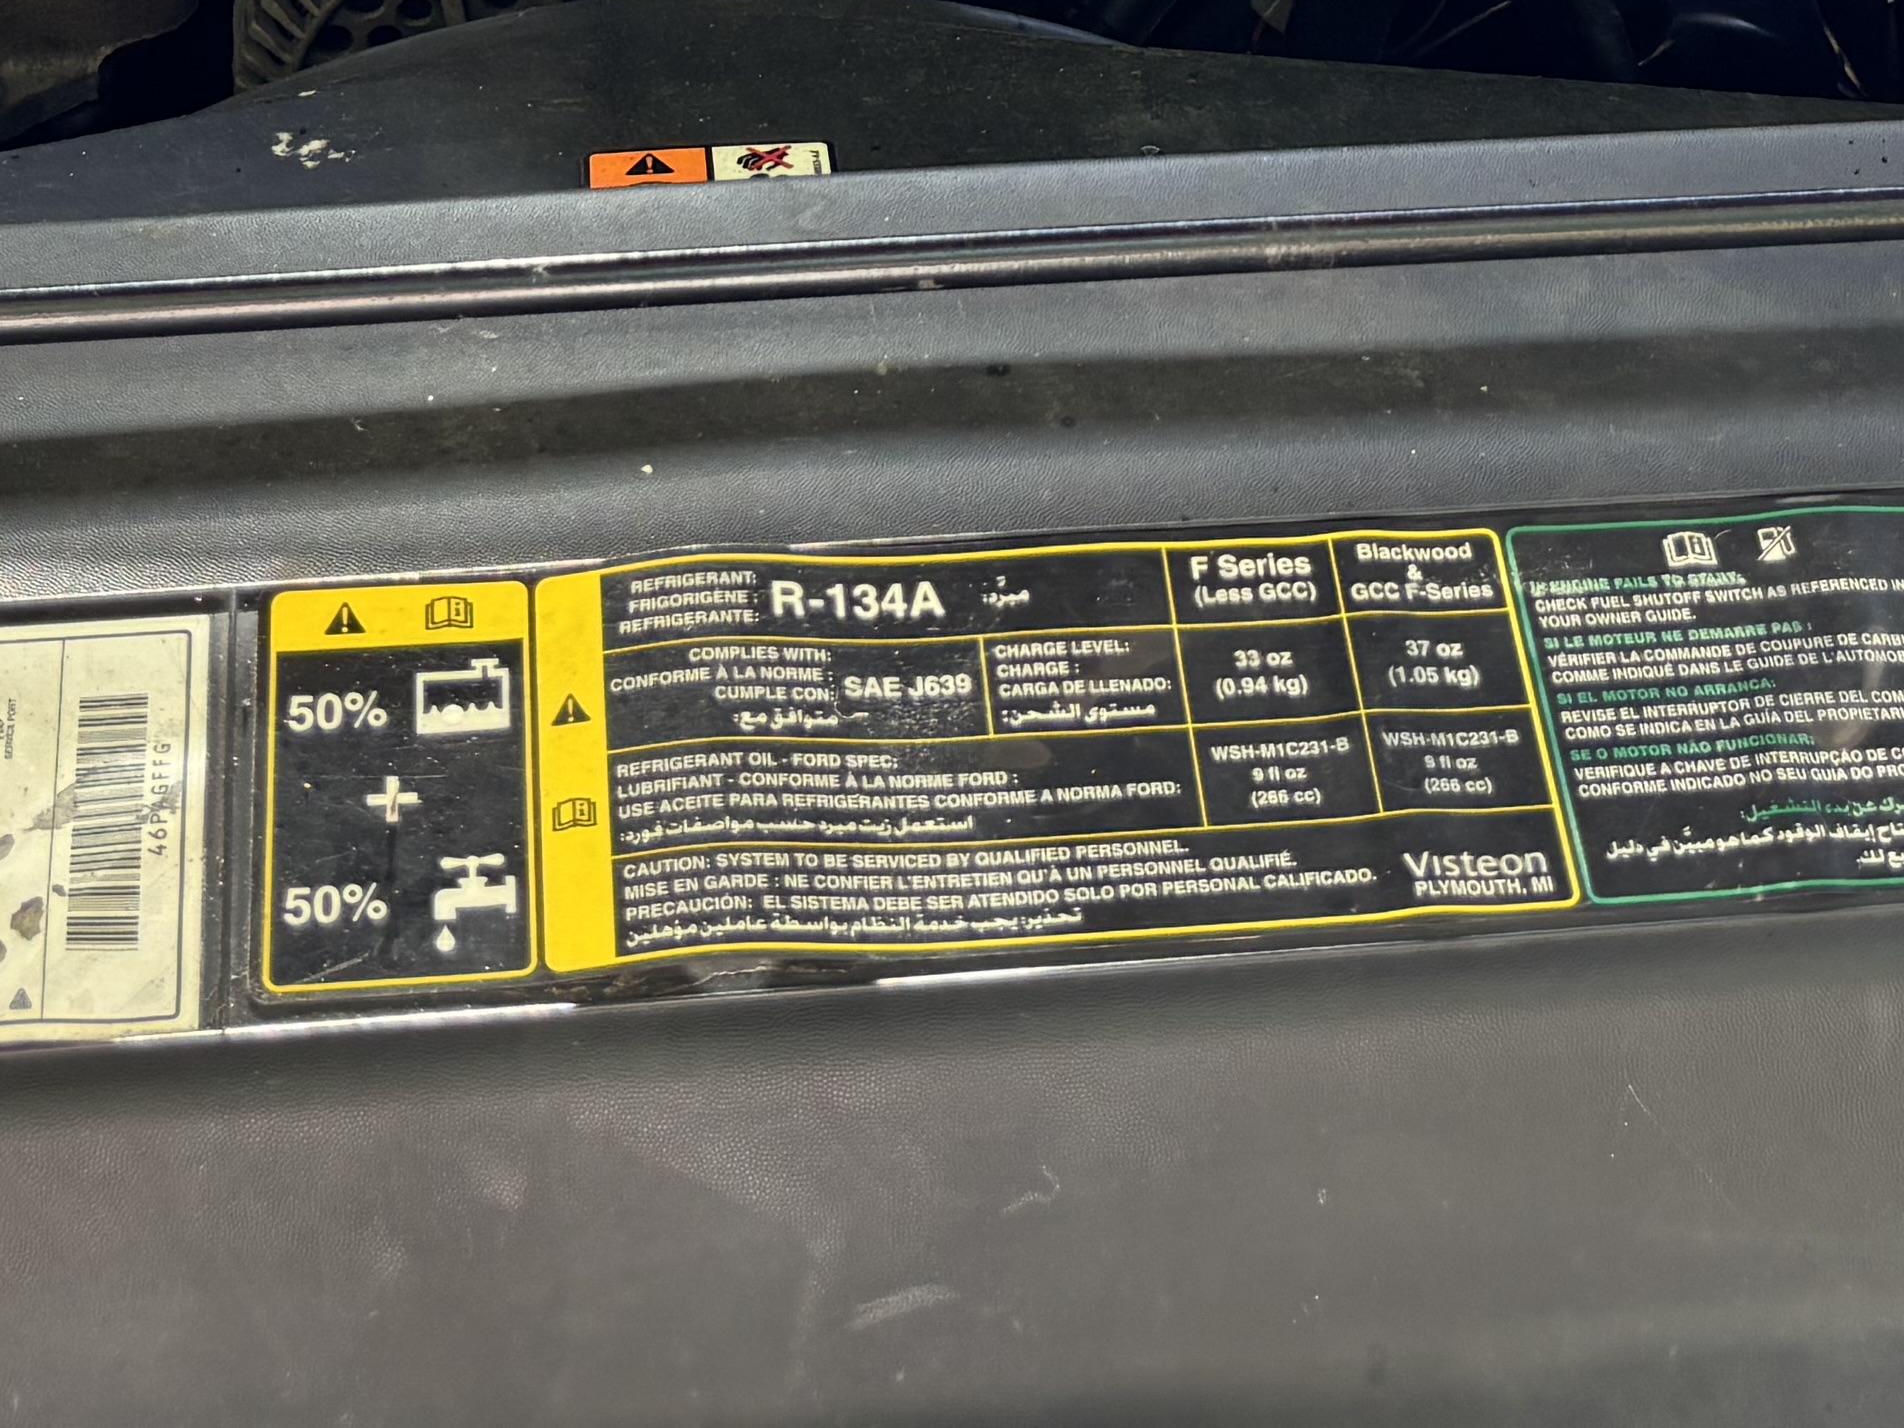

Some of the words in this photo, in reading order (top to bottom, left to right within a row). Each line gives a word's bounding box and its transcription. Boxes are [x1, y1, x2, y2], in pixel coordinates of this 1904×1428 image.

[1356, 541, 1472, 561] Blackwood
[1190, 555, 1208, 580] F
[1216, 552, 1312, 579] Series
[1404, 563, 1425, 582] &
[770, 579, 946, 620] R-134A
[1194, 585, 1254, 608] (Less
[1258, 580, 1317, 601] GCC)
[1350, 581, 1400, 601] GCC
[1404, 581, 1494, 601] F-Series
[1534, 597, 1588, 613] CHECK
[1590, 595, 1631, 610] FUEL
[1632, 590, 1701, 607] SHUTOFF
[1704, 586, 1764, 603] SWITCH
[1767, 584, 1787, 599] AS
[1790, 577, 1888, 595] REFERENCED
[1538, 613, 1582, 628] YOUR
[1584, 610, 1642, 626] OWNER
[1645, 607, 1696, 622] GUIDE.
[992, 641, 1068, 659] CHARGE
[1070, 639, 1130, 655] LEVEL:
[1233, 649, 1261, 668] 33
[1265, 651, 1293, 667] oz
[1405, 639, 1430, 656] 37
[1435, 642, 1464, 658] oz
[843, 675, 903, 699] SAE
[907, 672, 972, 699] J639
[1388, 665, 1439, 687] (1.05
[1443, 664, 1480, 687] kg)
[1215, 675, 1268, 700] (0.94
[1272, 673, 1308, 696] kg)
[287, 691, 388, 732] 50%
[1381, 728, 1519, 747] WSH-M1C231-B
[1210, 736, 1350, 761] WSH-M1C231-B
[1423, 754, 1436, 769] 9
[1438, 754, 1451, 769] fl
[1455, 757, 1478, 770] oz
[1251, 767, 1264, 782] 9
[1267, 765, 1280, 781] fl
[1284, 767, 1308, 780] oz
[1424, 777, 1461, 794] (266
[1464, 776, 1493, 794] cc)
[1251, 789, 1290, 808] (266
[1292, 787, 1321, 805] cc)
[623, 855, 710, 879] CAUTION:
[715, 852, 790, 868] SYSTEM
[793, 852, 819, 867] TO
[823, 853, 848, 868] BE
[849, 853, 942, 869] SERVICED
[945, 852, 970, 868] BY
[974, 846, 1071, 866] QUALIFIED
[1075, 839, 1189, 859] PERSONNEL.
[1402, 850, 1548, 878] Visteon
[1414, 877, 1527, 896] PLYMOUTH,
[1530, 875, 1554, 893] MI
[284, 884, 388, 926] 50%
